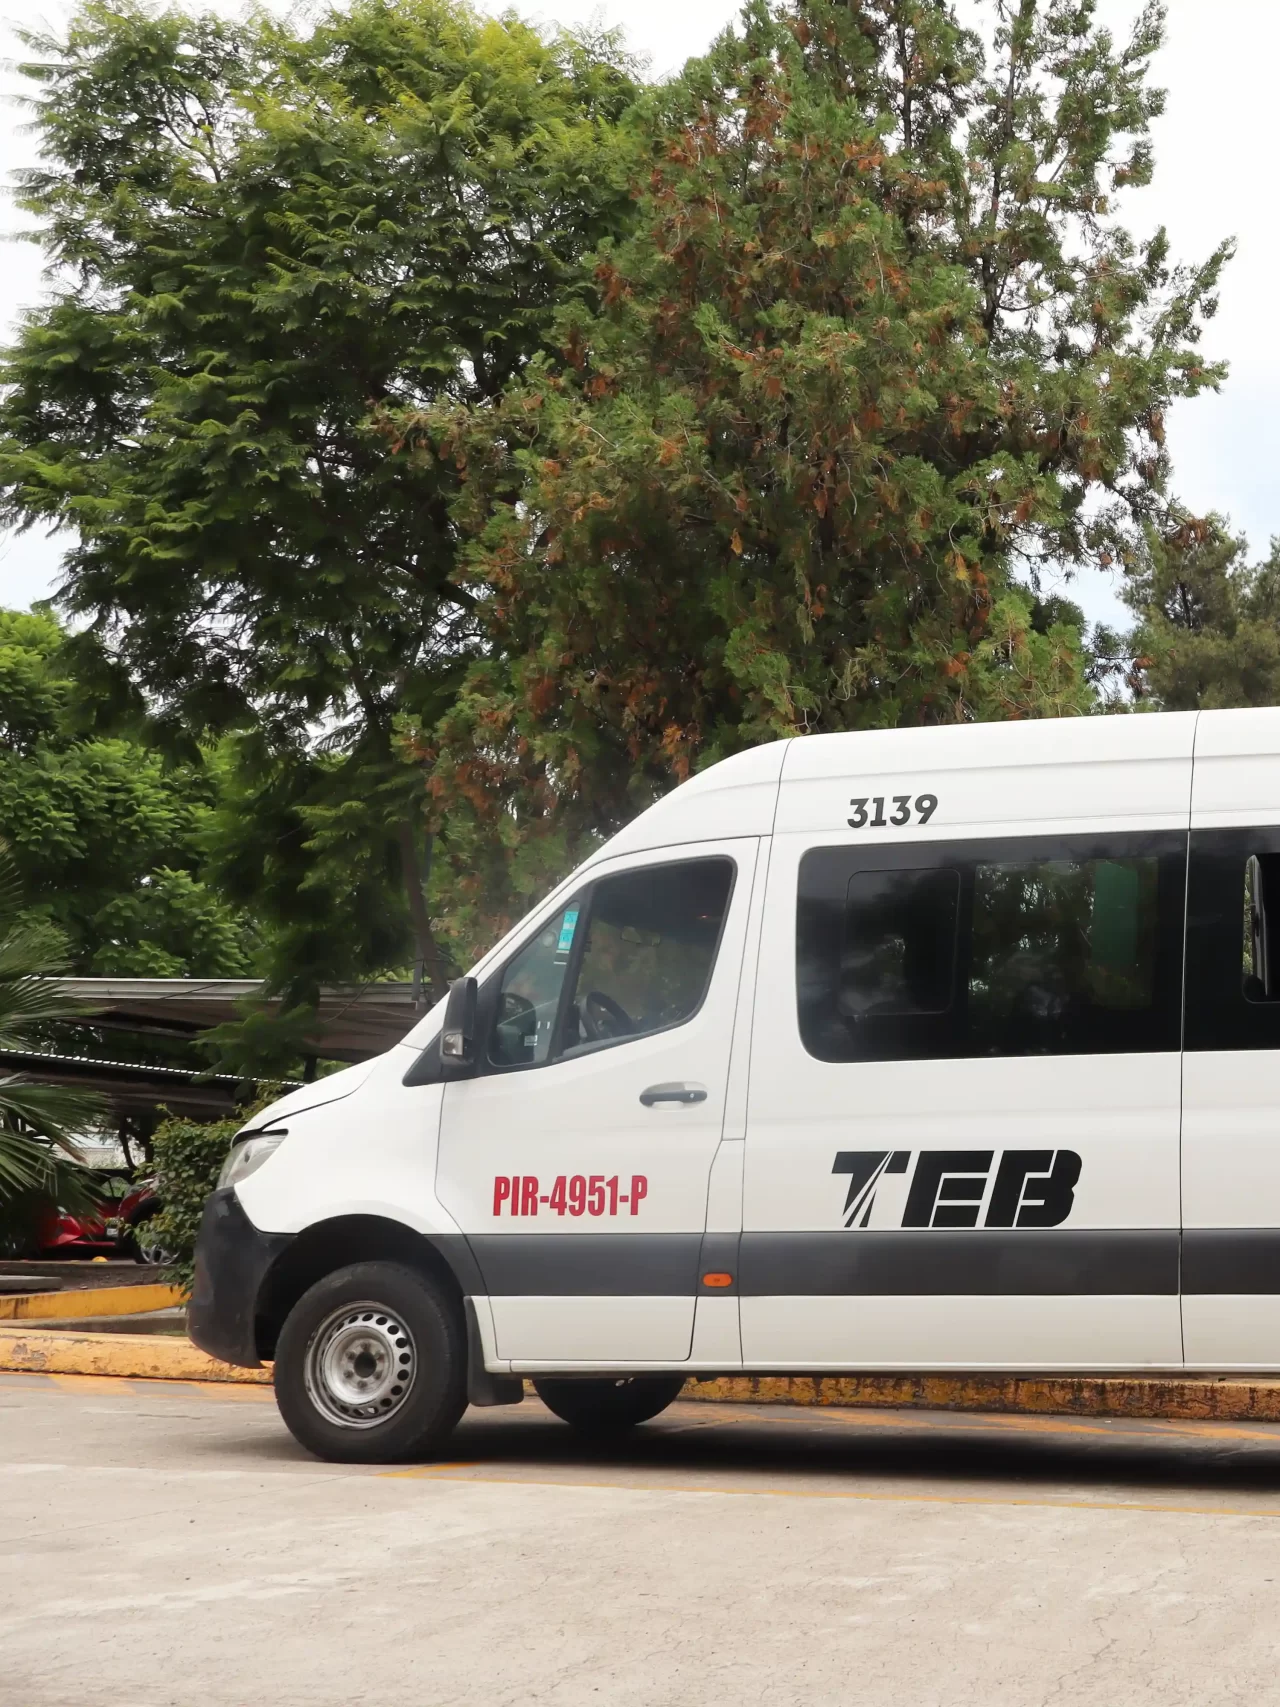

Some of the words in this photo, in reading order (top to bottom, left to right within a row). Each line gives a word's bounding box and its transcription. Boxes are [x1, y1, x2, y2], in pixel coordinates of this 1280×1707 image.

[847, 795, 938, 828] 3139
[493, 1175, 648, 1217] PIR-4951-P
[831, 1150, 1083, 1228] TEB
